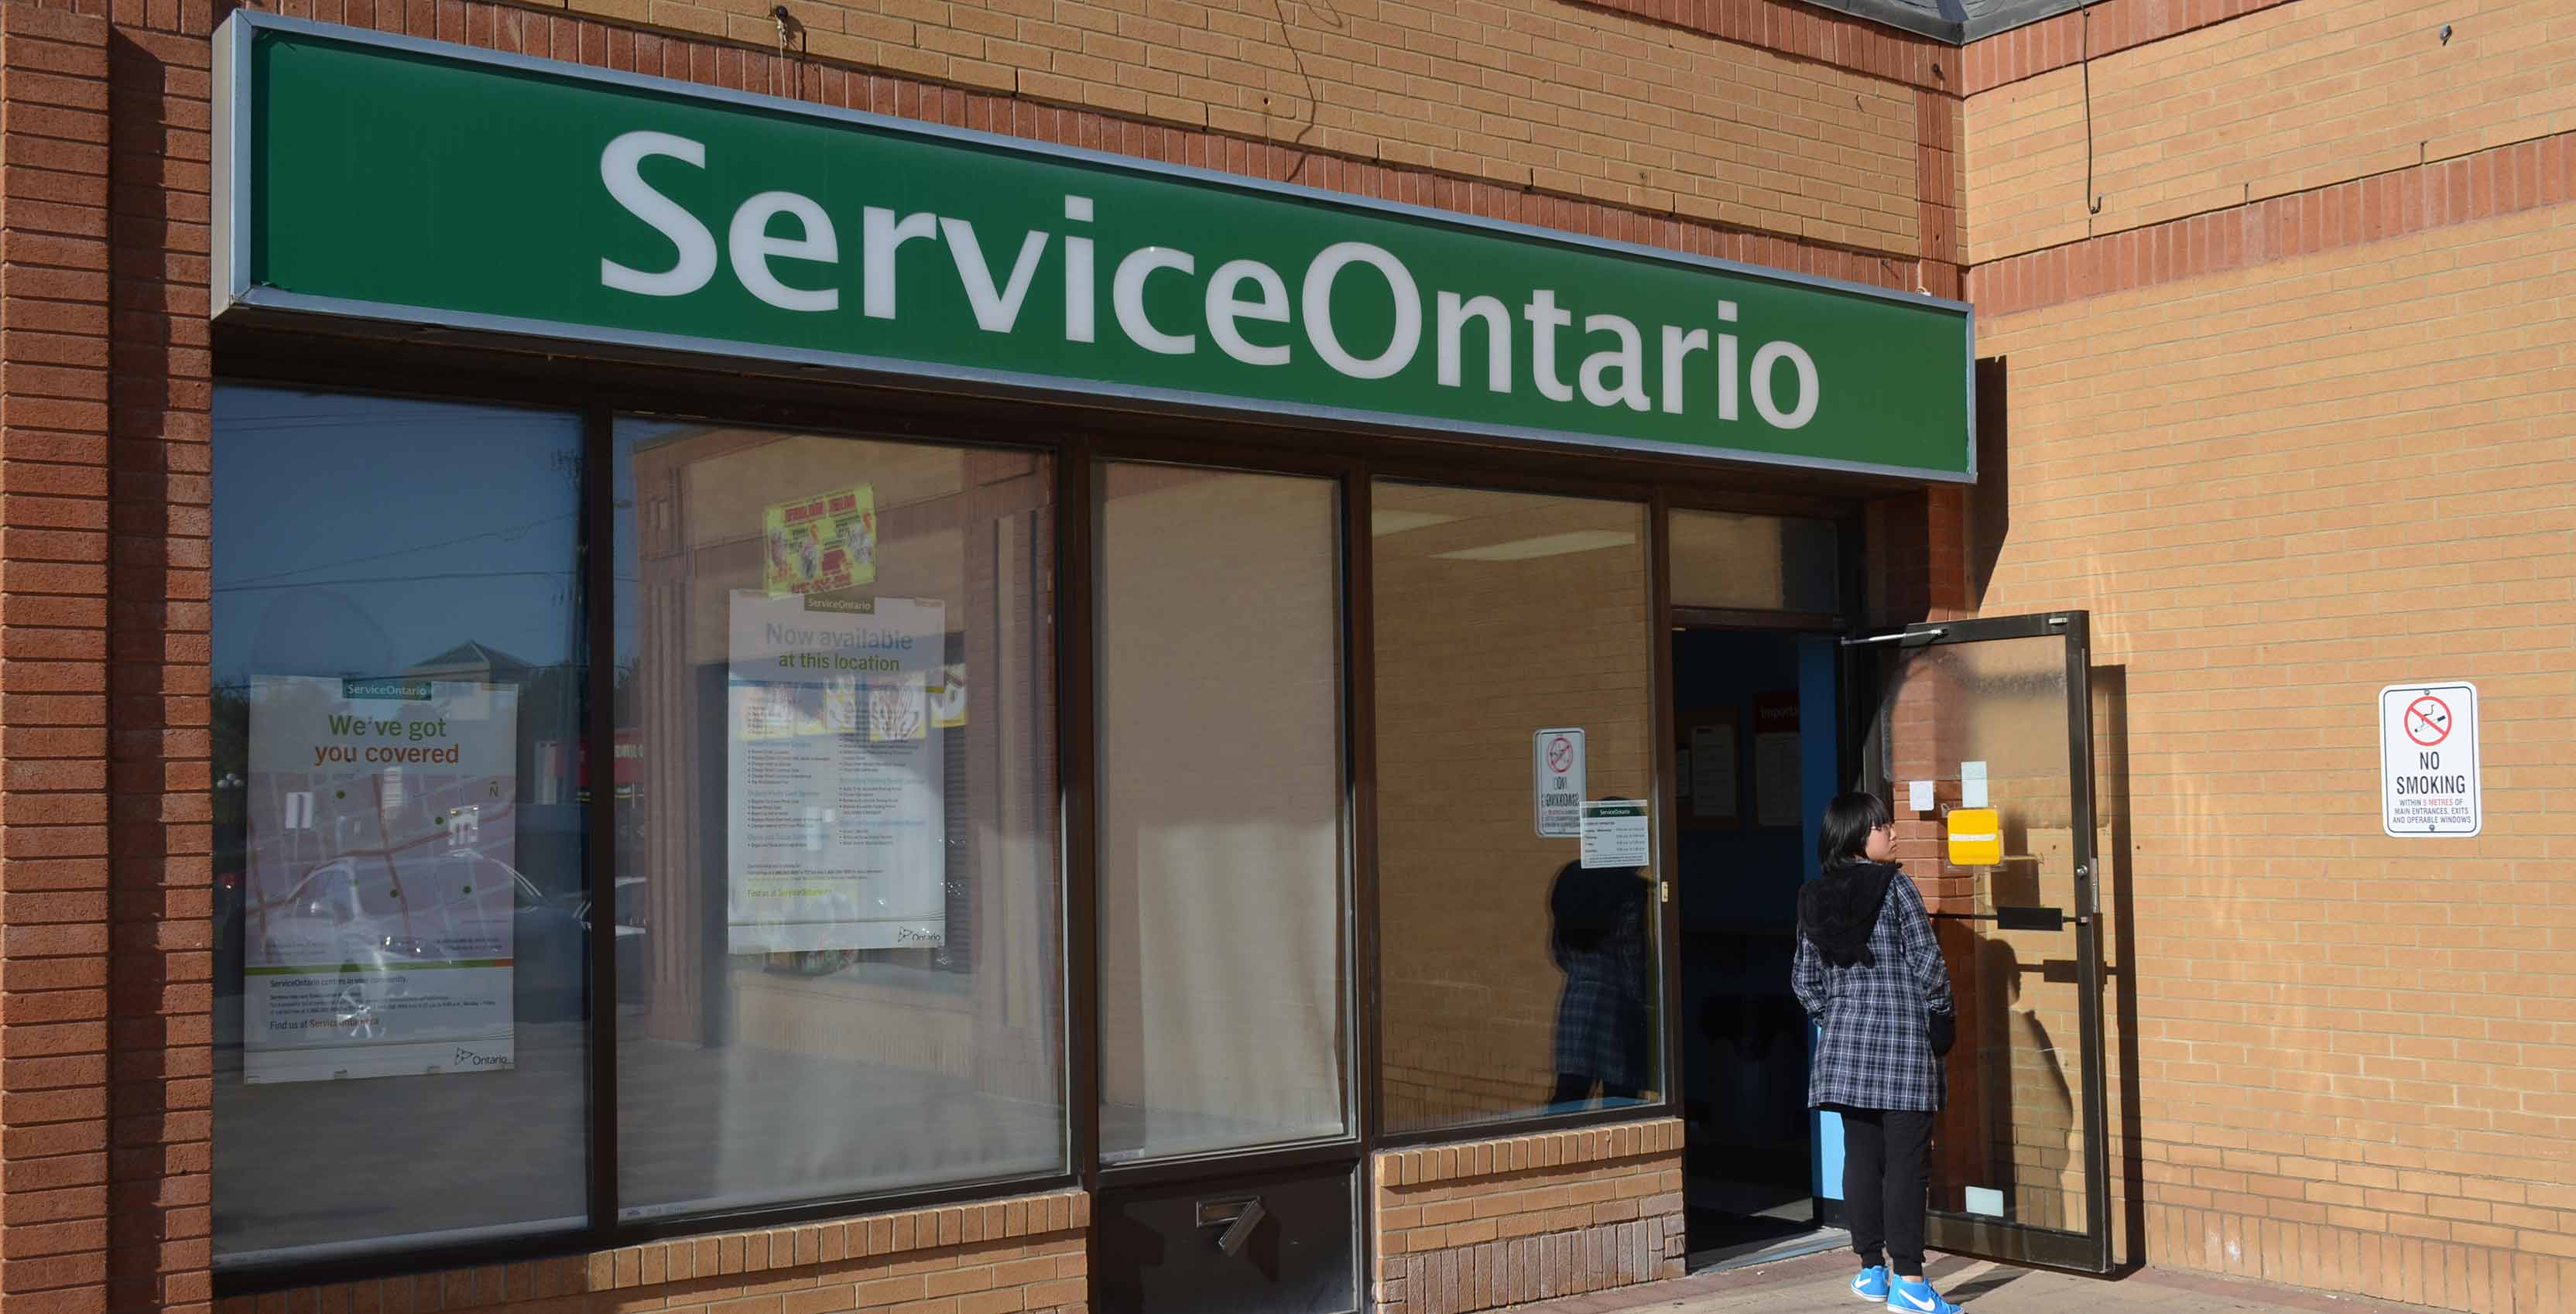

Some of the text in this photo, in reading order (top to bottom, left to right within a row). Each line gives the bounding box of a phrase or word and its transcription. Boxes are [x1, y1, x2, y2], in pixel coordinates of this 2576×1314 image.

[600, 130, 1821, 431] ServiceOntario
[808, 599, 871, 611] ServiceOntario
[766, 622, 913, 650] Now available
[779, 652, 900, 672] at this location
[347, 683, 426, 697] ServiceOntario
[328, 713, 447, 741] We've got
[314, 742, 459, 767] you covered
[2420, 751, 2440, 770] NO
[2396, 775, 2465, 795] SMOKING
[2393, 815, 2472, 824] AND OPERABLE WINDOWS
[2394, 807, 2411, 816] MAIN
[912, 932, 941, 942] Ontario
[270, 1021, 287, 1030] Find
[289, 1021, 300, 1030] us
[301, 1020, 308, 1029] at
[472, 1054, 508, 1066] Ontario
